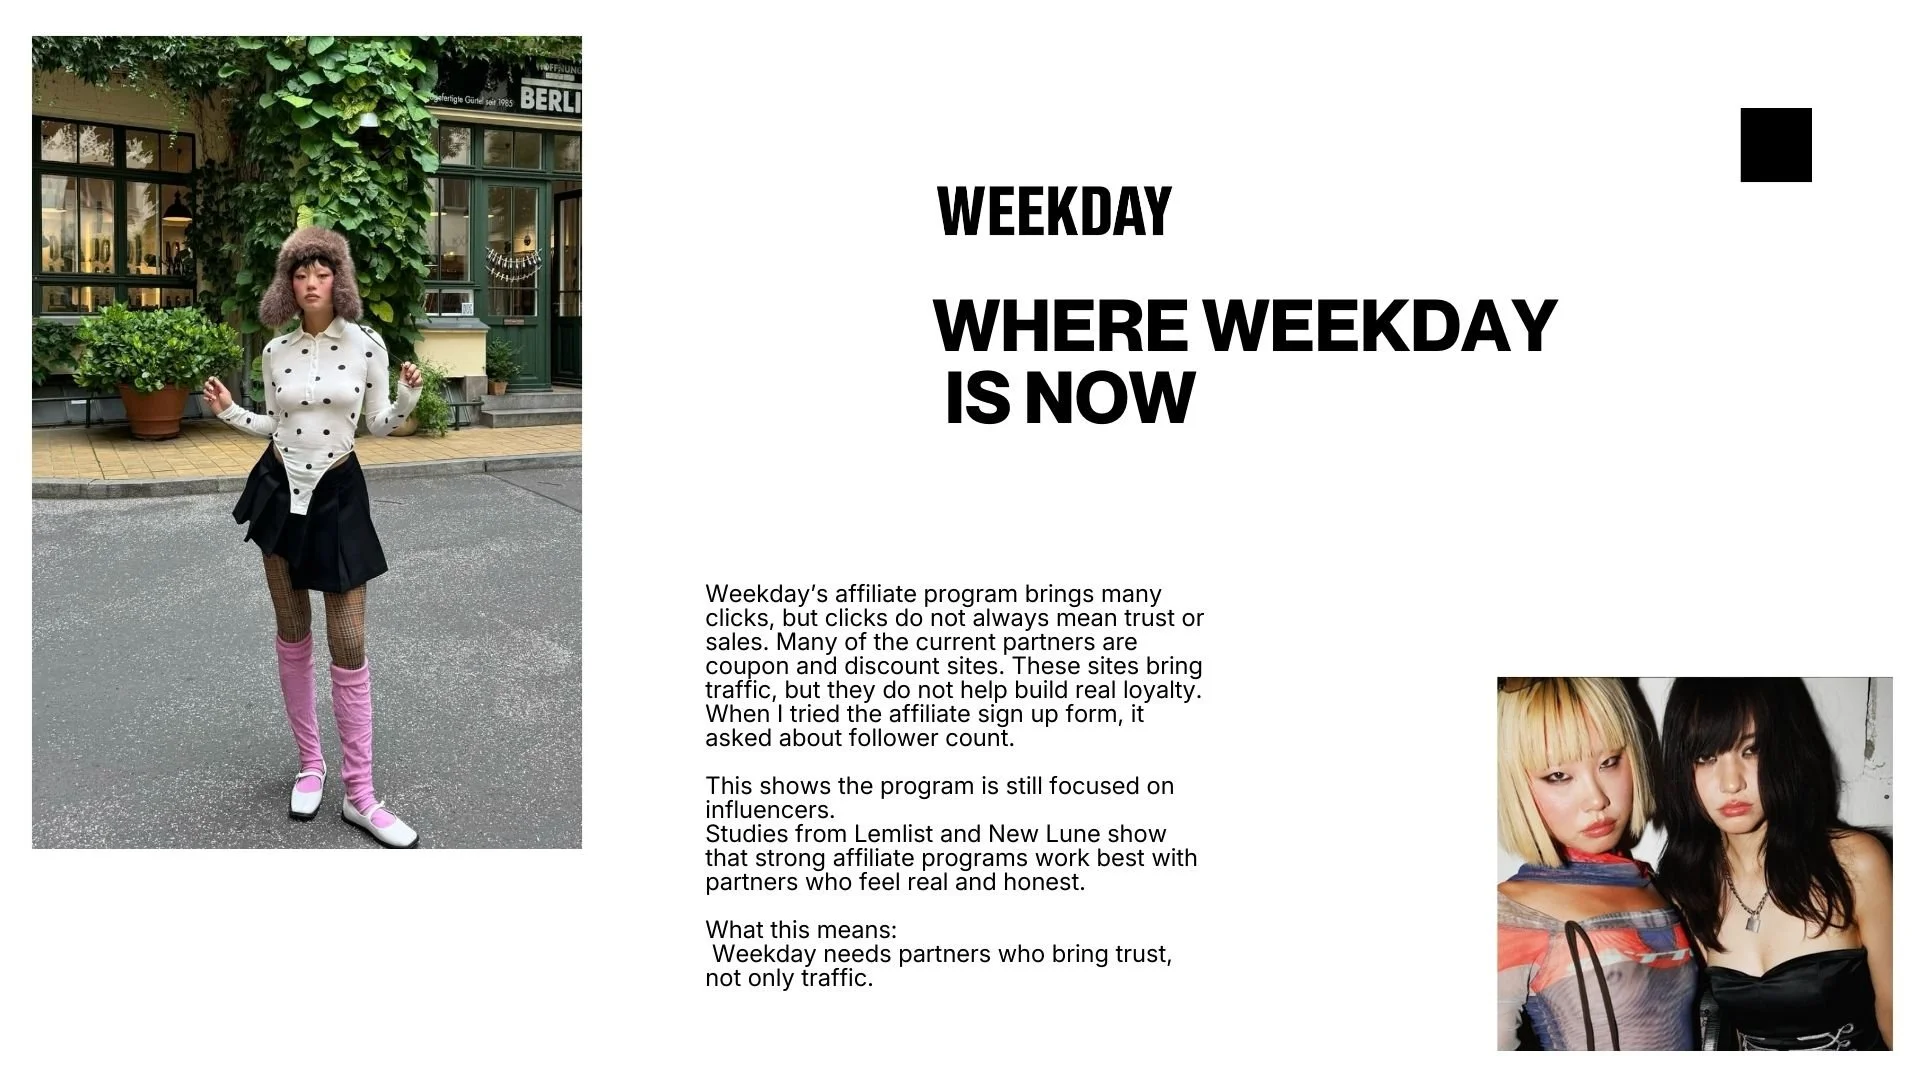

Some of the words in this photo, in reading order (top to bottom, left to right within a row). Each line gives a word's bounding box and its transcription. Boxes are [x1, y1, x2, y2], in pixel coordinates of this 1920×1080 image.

[464, 95, 484, 105] Gürtel
[485, 98, 496, 106] seit
[520, 86, 582, 114] BERLI
